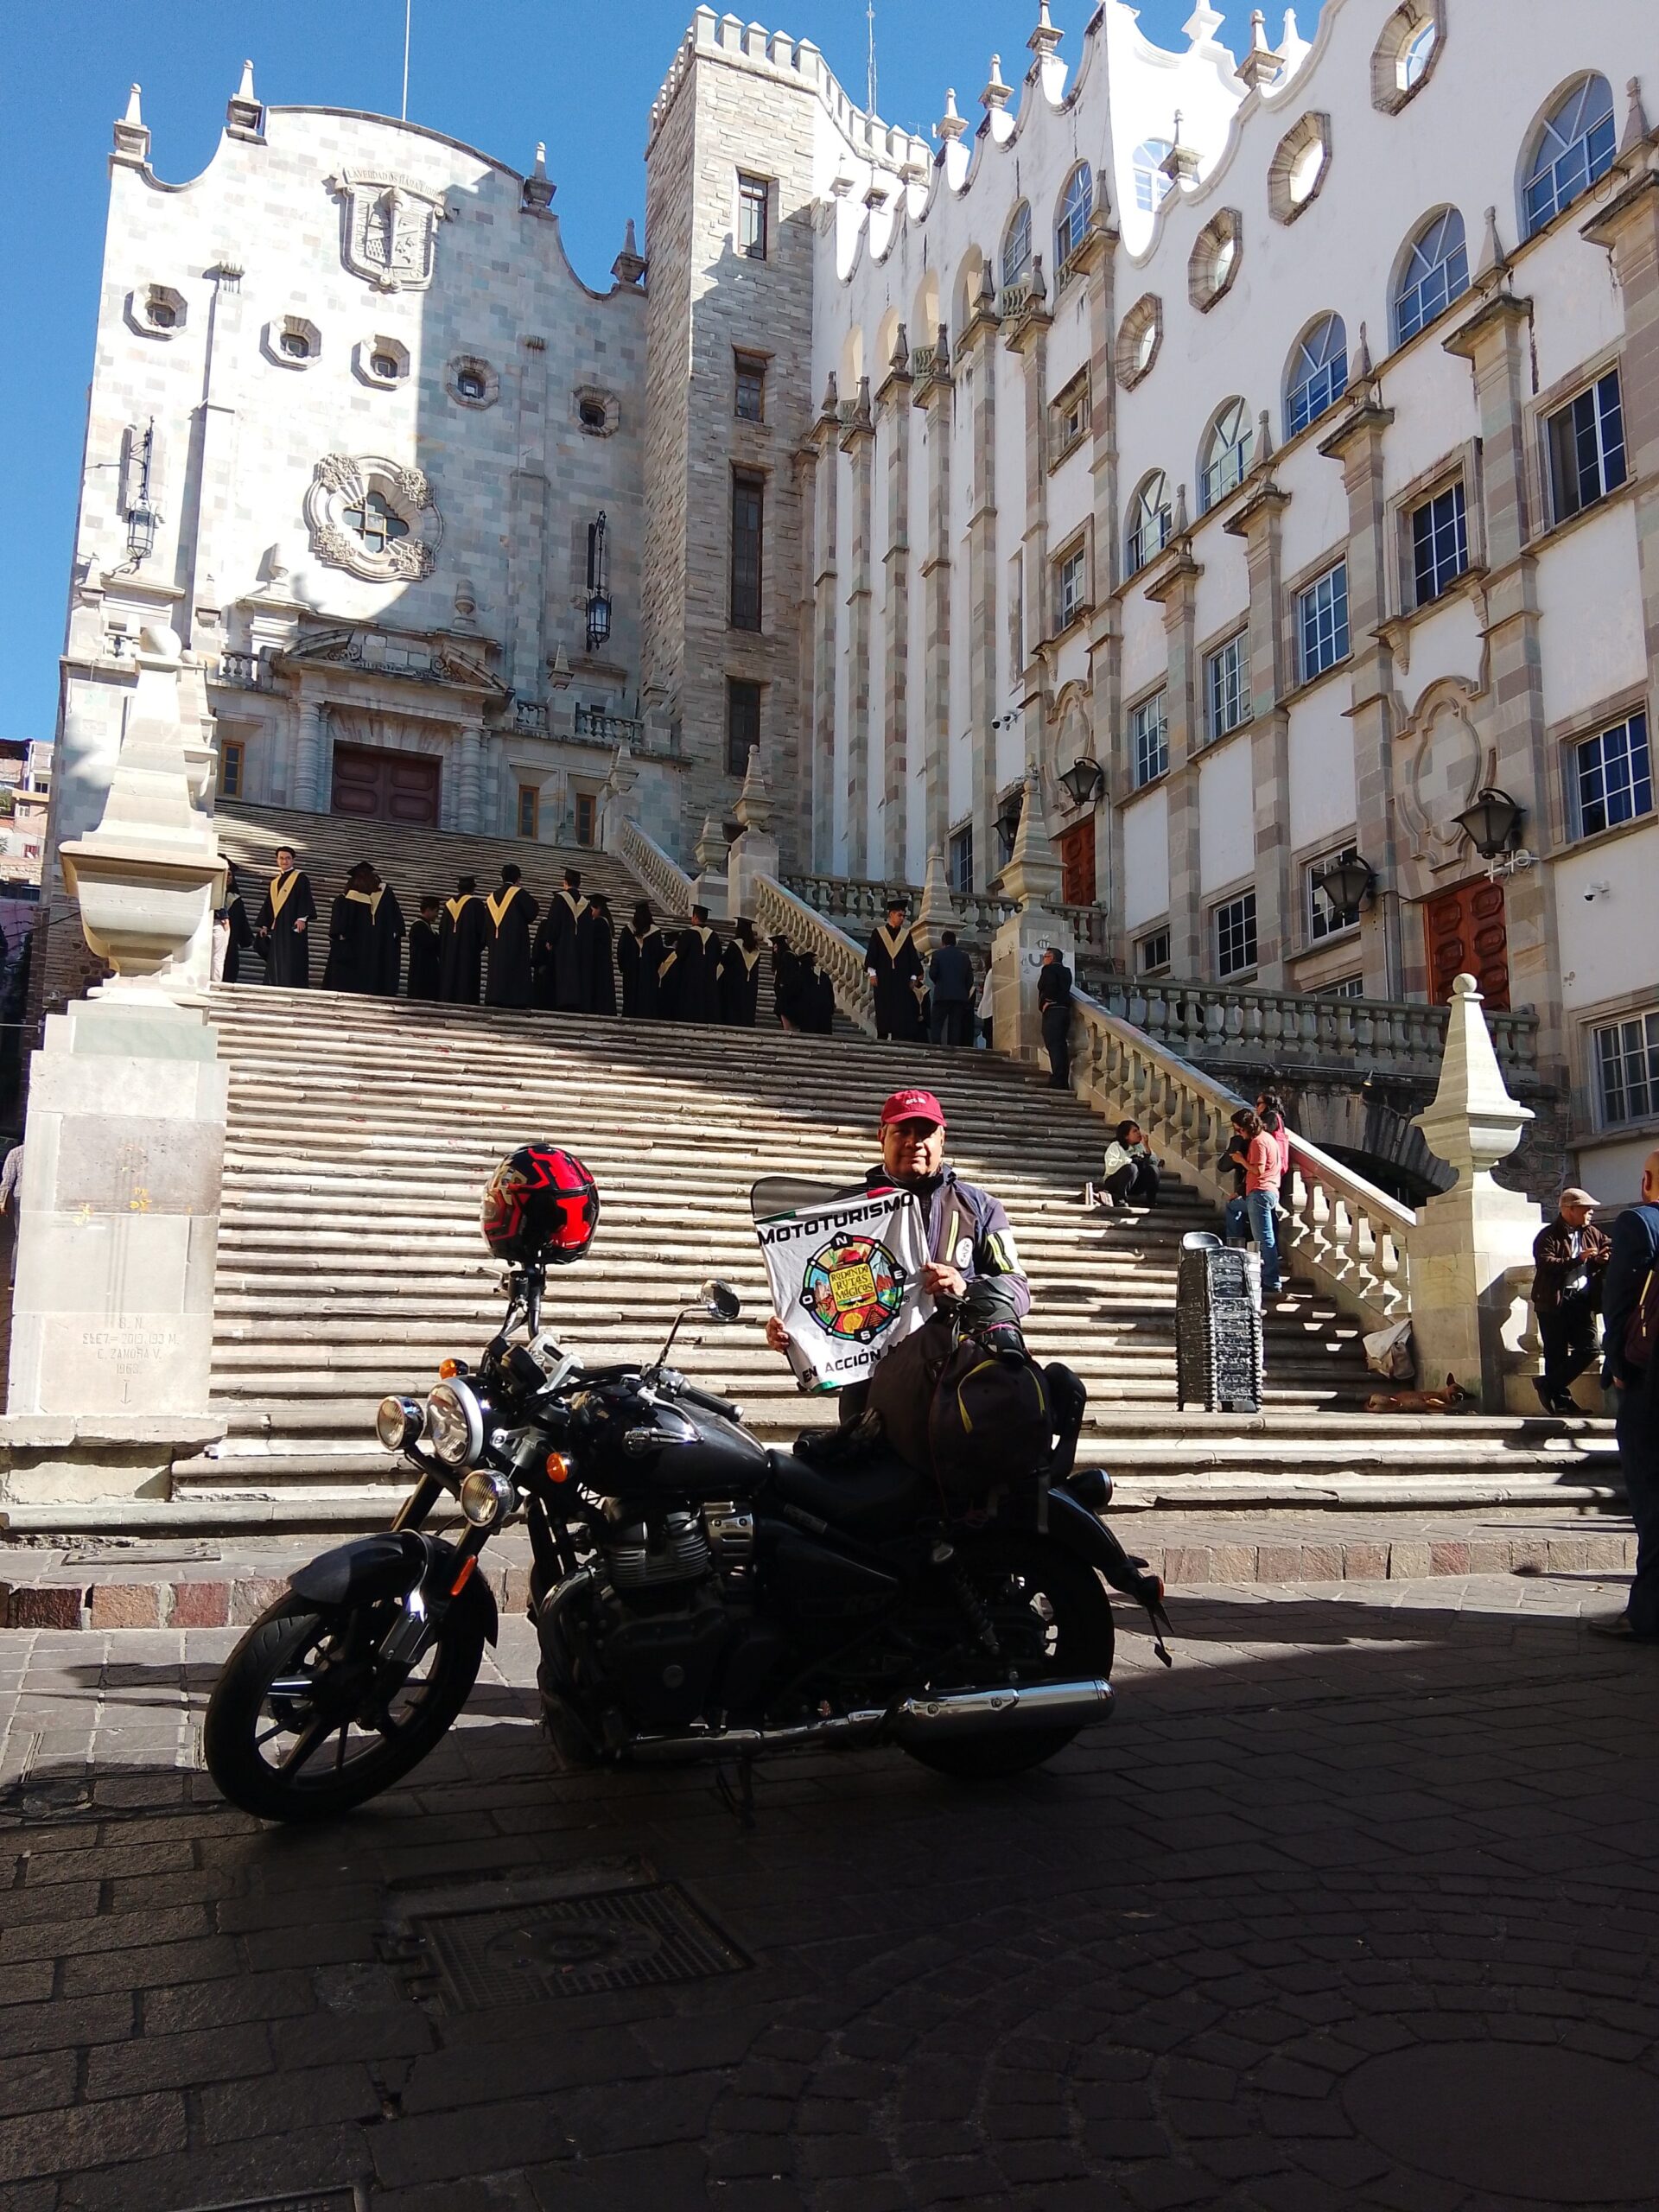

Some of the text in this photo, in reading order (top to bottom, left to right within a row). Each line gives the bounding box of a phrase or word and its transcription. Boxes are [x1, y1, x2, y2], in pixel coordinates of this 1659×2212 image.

[757, 1192, 914, 1247] MOTOTURISMO
[835, 1236, 848, 1246] N
[893, 1269, 905, 1280] E
[860, 1331, 871, 1340] S
[802, 1348, 881, 1382] EN ACCIÓN
